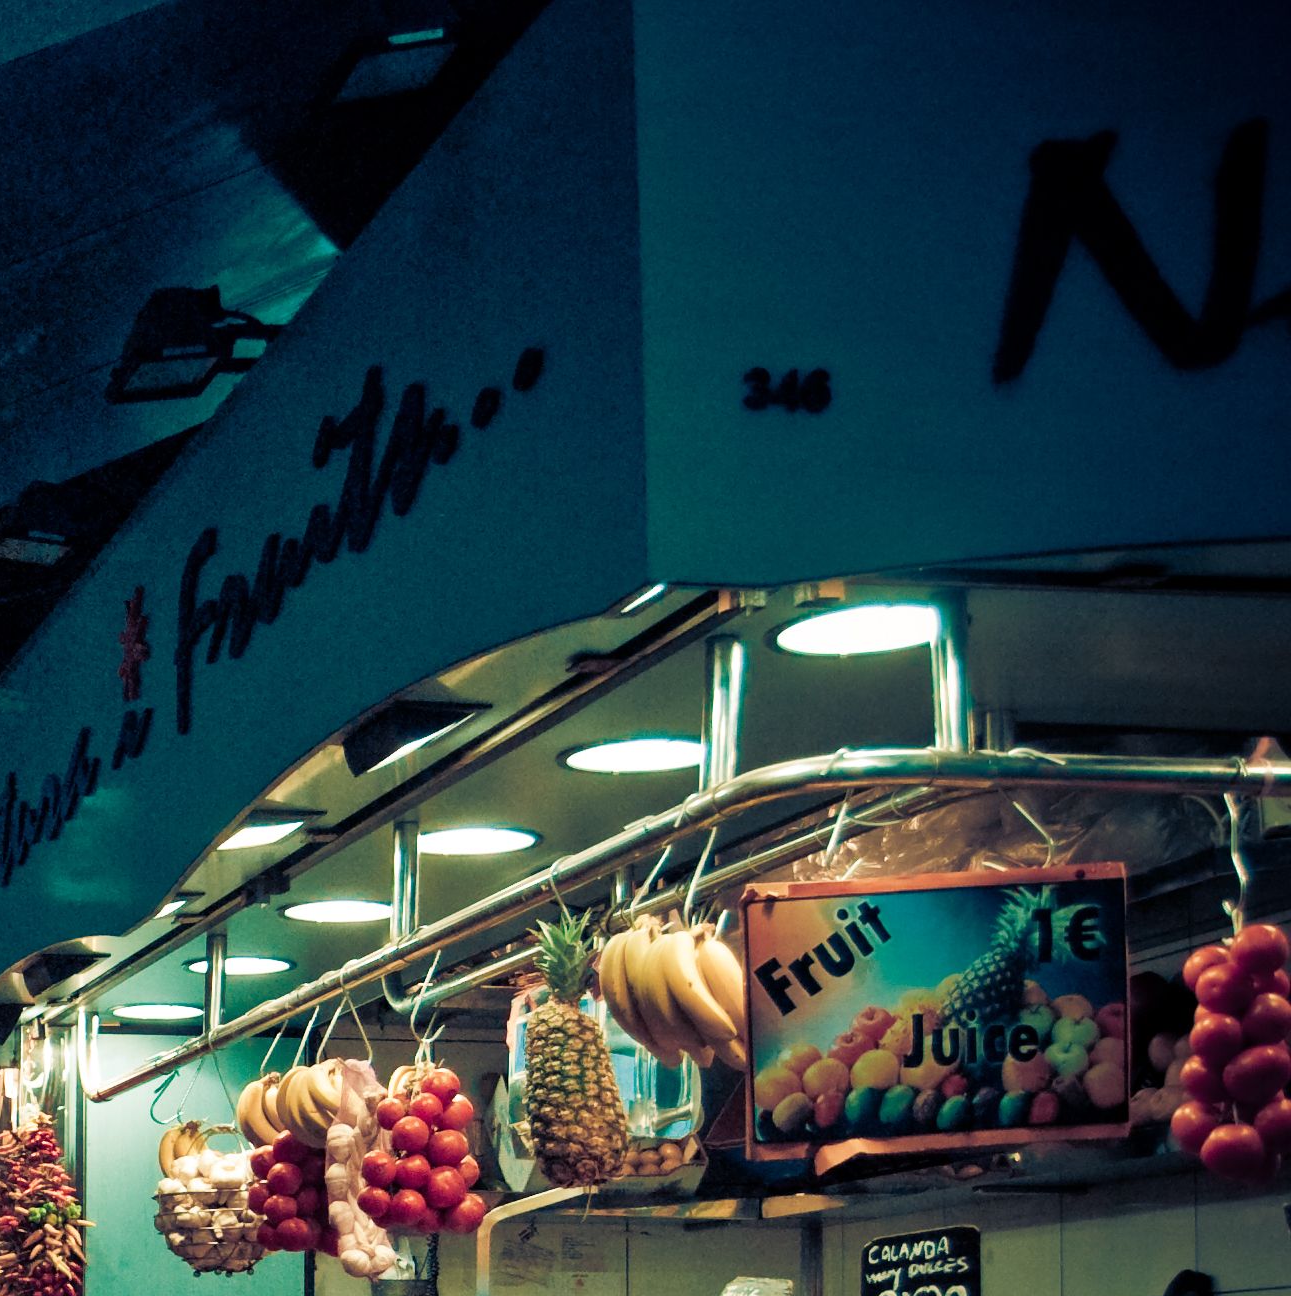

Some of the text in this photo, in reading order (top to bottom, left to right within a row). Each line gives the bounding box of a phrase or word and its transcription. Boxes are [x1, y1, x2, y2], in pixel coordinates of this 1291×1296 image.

[991, 118, 1291, 388] N
[754, 900, 892, 1016] Fruit
[903, 1009, 1040, 1068] Juice
